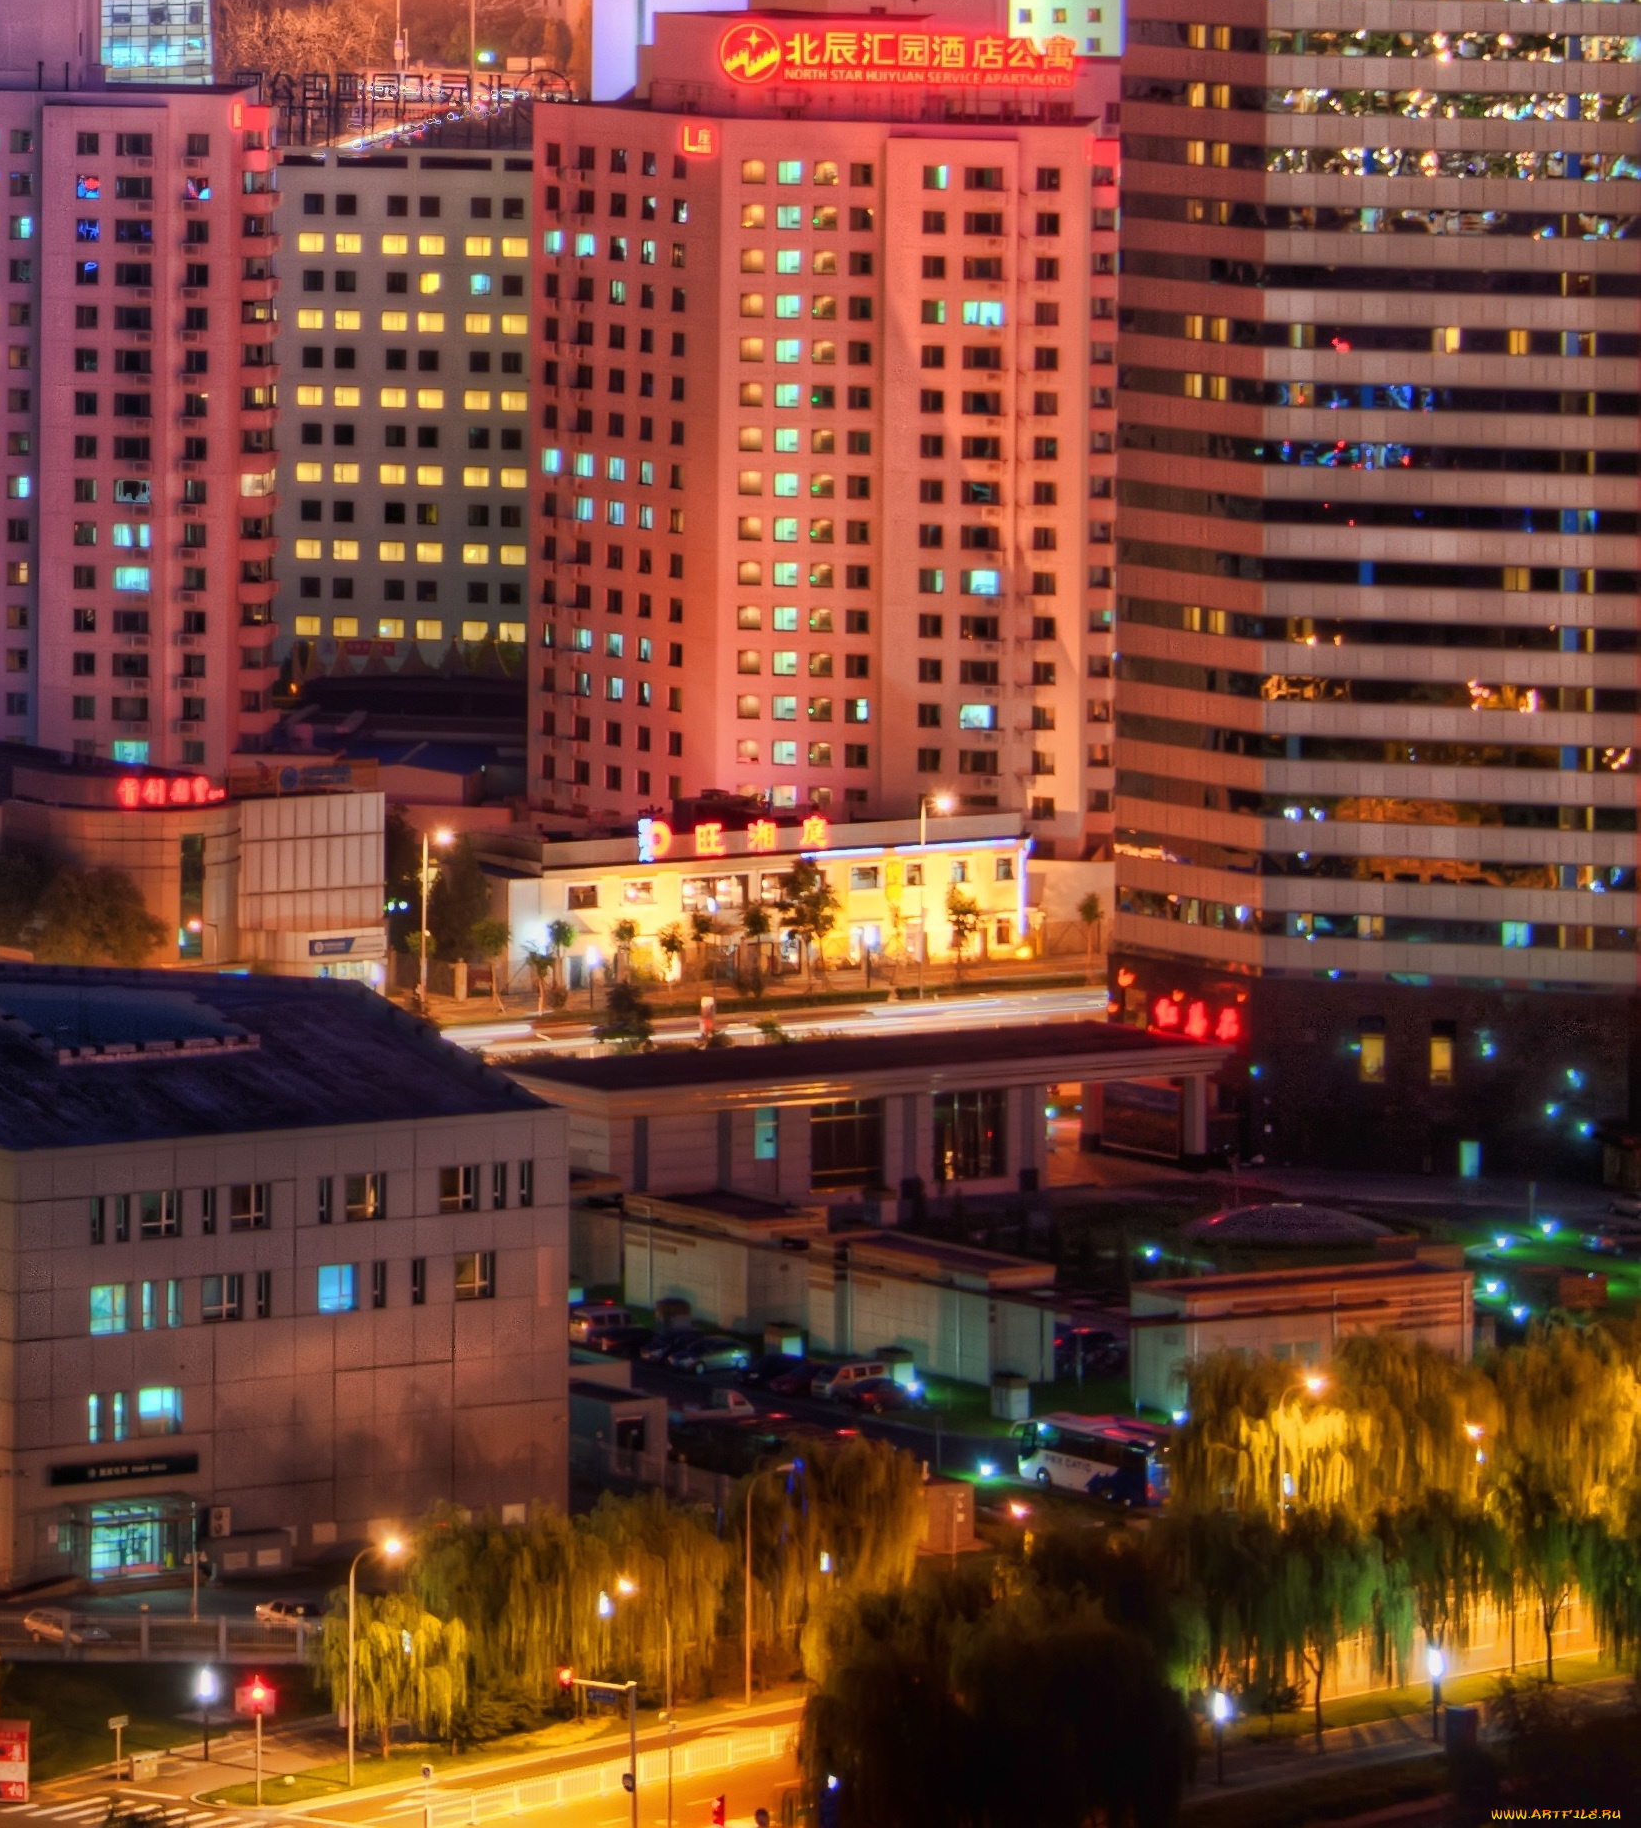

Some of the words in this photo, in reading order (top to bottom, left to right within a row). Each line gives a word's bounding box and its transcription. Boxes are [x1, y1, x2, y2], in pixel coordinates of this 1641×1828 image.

[785, 32, 1075, 71] 北辰汇园酒店公寓
[784, 68, 827, 80] NORTH
[829, 69, 863, 81] STAR
[865, 70, 924, 83] HUIYUAN
[927, 71, 980, 84] SERVICE
[983, 73, 1072, 86] APARTMENTS
[695, 815, 828, 856] 旺湘庭
